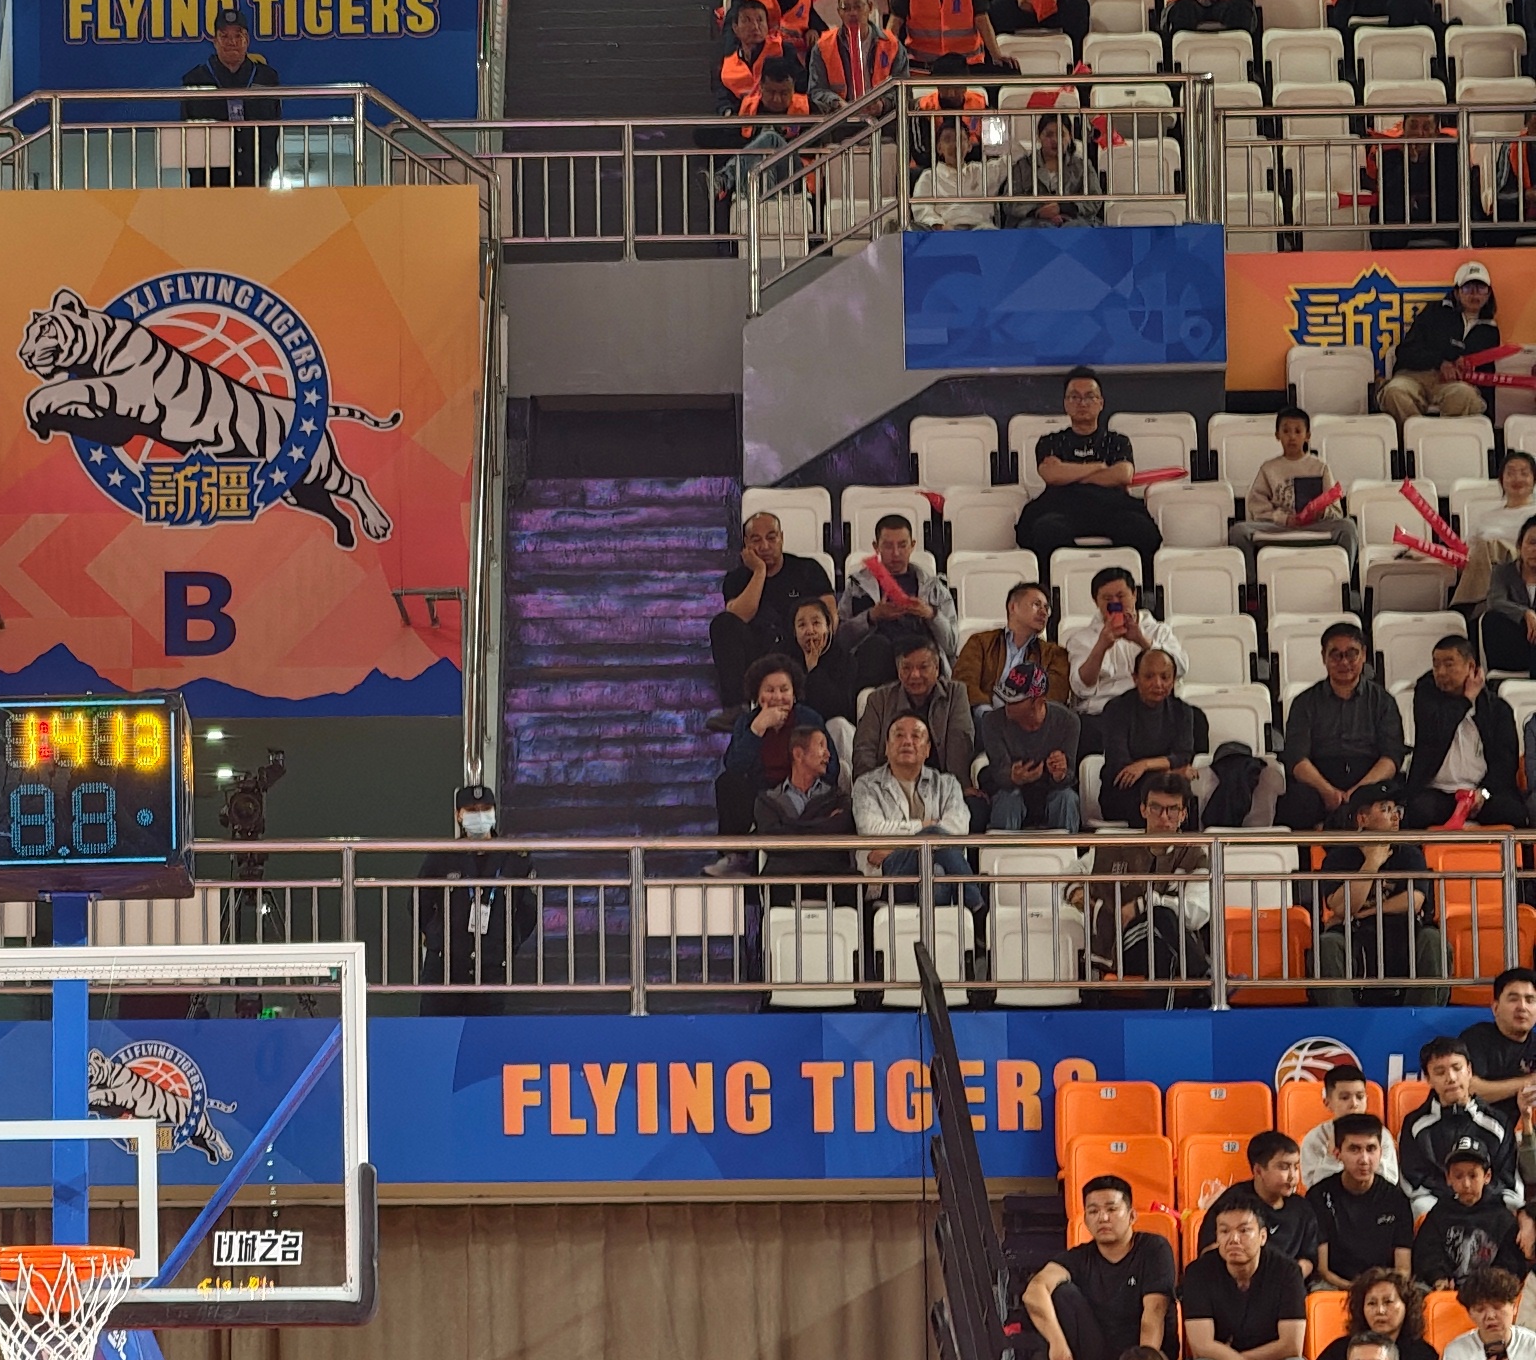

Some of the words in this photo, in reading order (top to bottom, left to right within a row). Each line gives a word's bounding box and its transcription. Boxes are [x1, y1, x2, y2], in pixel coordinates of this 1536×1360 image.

[123, 284, 157, 318] XJ
[159, 275, 256, 310] FLYING
[255, 293, 323, 384] TIGERS
[147, 461, 252, 521] 新疆
[163, 571, 236, 657] B
[133, 1042, 174, 1060] FLYING
[172, 1050, 203, 1091] TIGERS
[502, 1060, 772, 1136] FLYING
[213, 1229, 304, 1267] 以城之名
